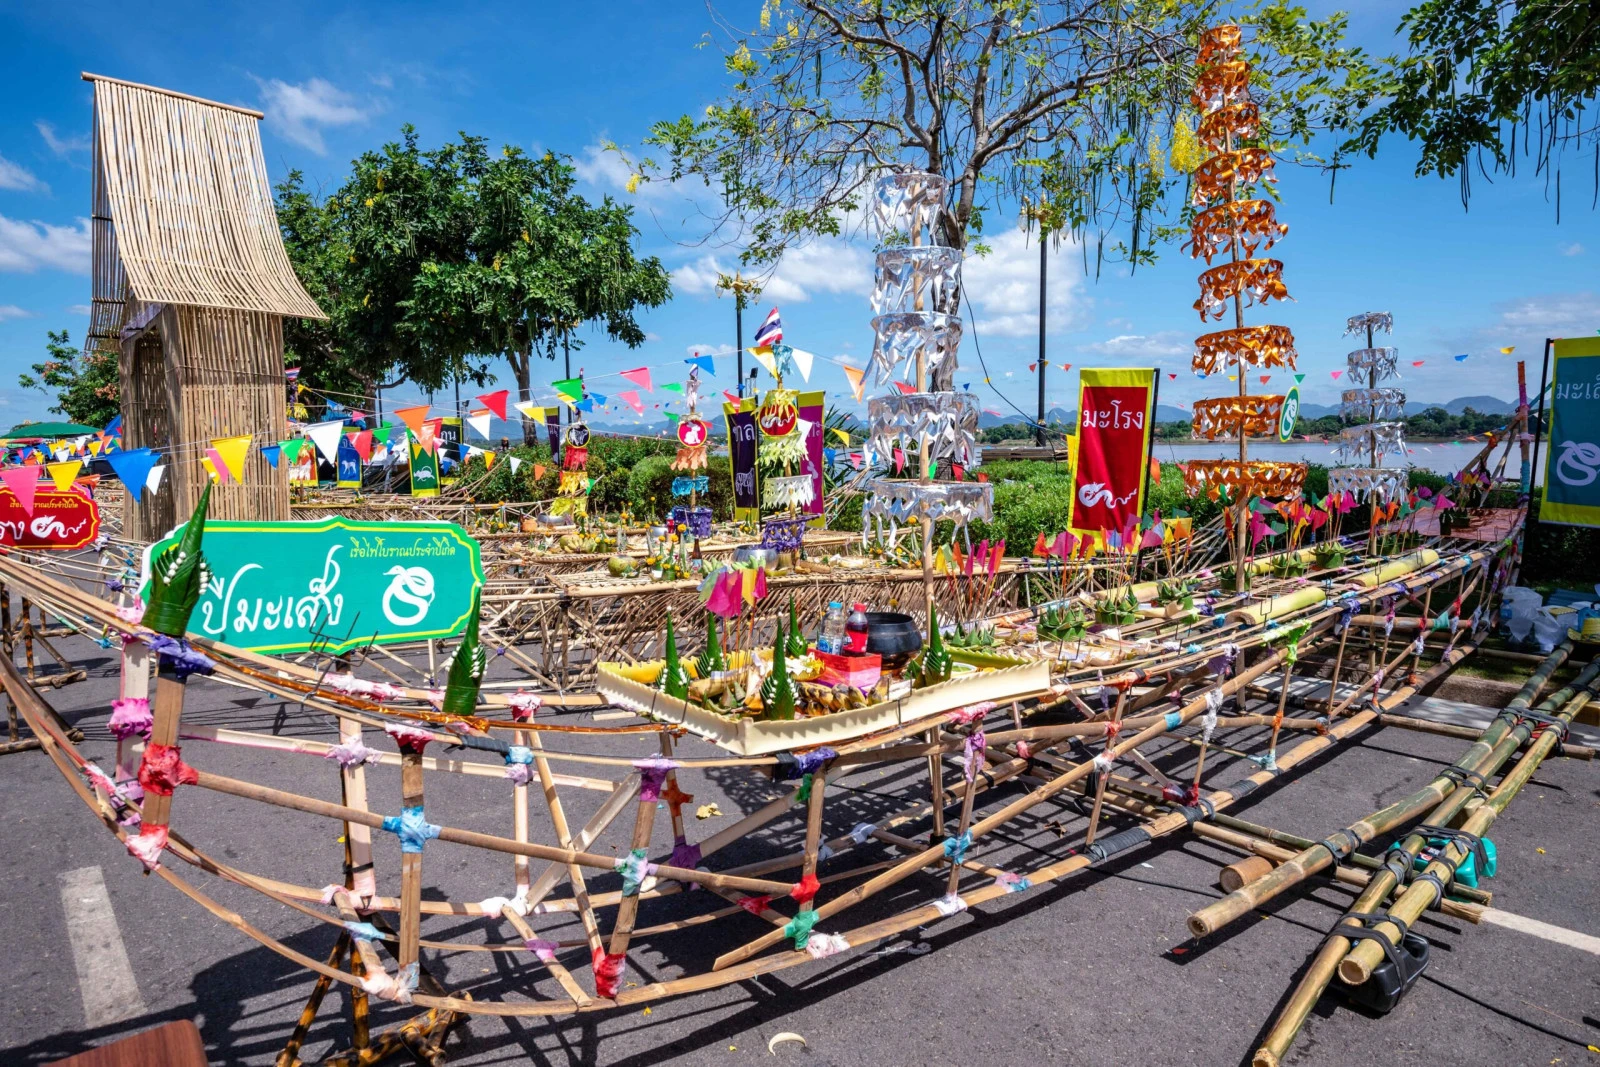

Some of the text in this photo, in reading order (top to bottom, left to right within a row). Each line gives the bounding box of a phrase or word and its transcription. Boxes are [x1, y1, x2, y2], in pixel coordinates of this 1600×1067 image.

[1082, 399, 1144, 430] มะโรง
[202, 544, 344, 634] ปีมะเส็ง
